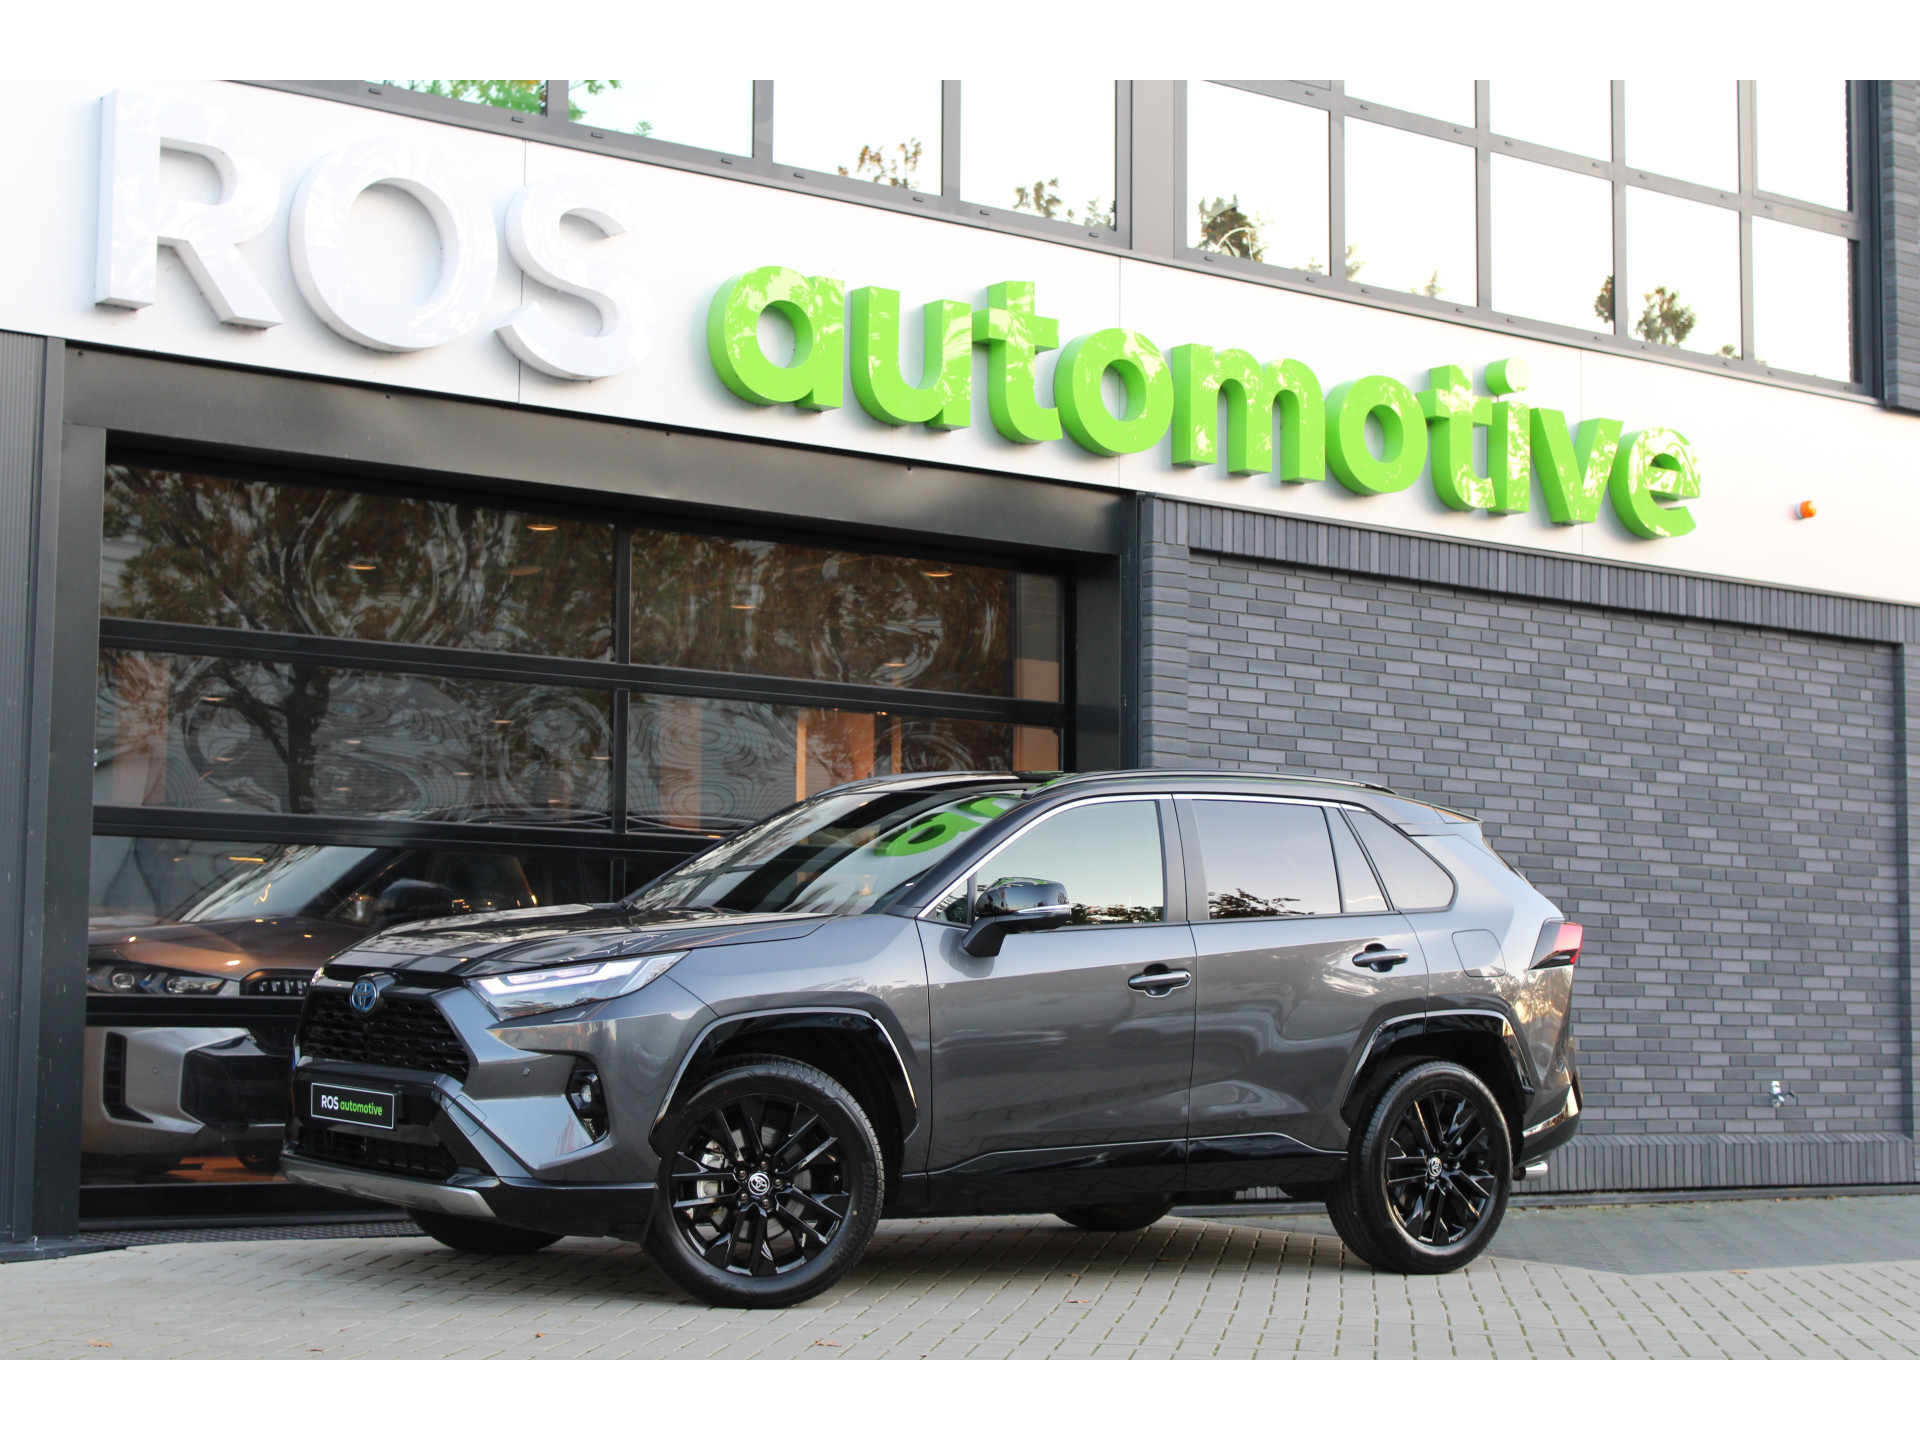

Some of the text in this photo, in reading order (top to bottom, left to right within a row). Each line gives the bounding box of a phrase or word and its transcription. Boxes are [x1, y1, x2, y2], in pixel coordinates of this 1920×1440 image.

[95, 88, 1701, 540] ROS automotive
[321, 1094, 383, 1116] ROS automotive
